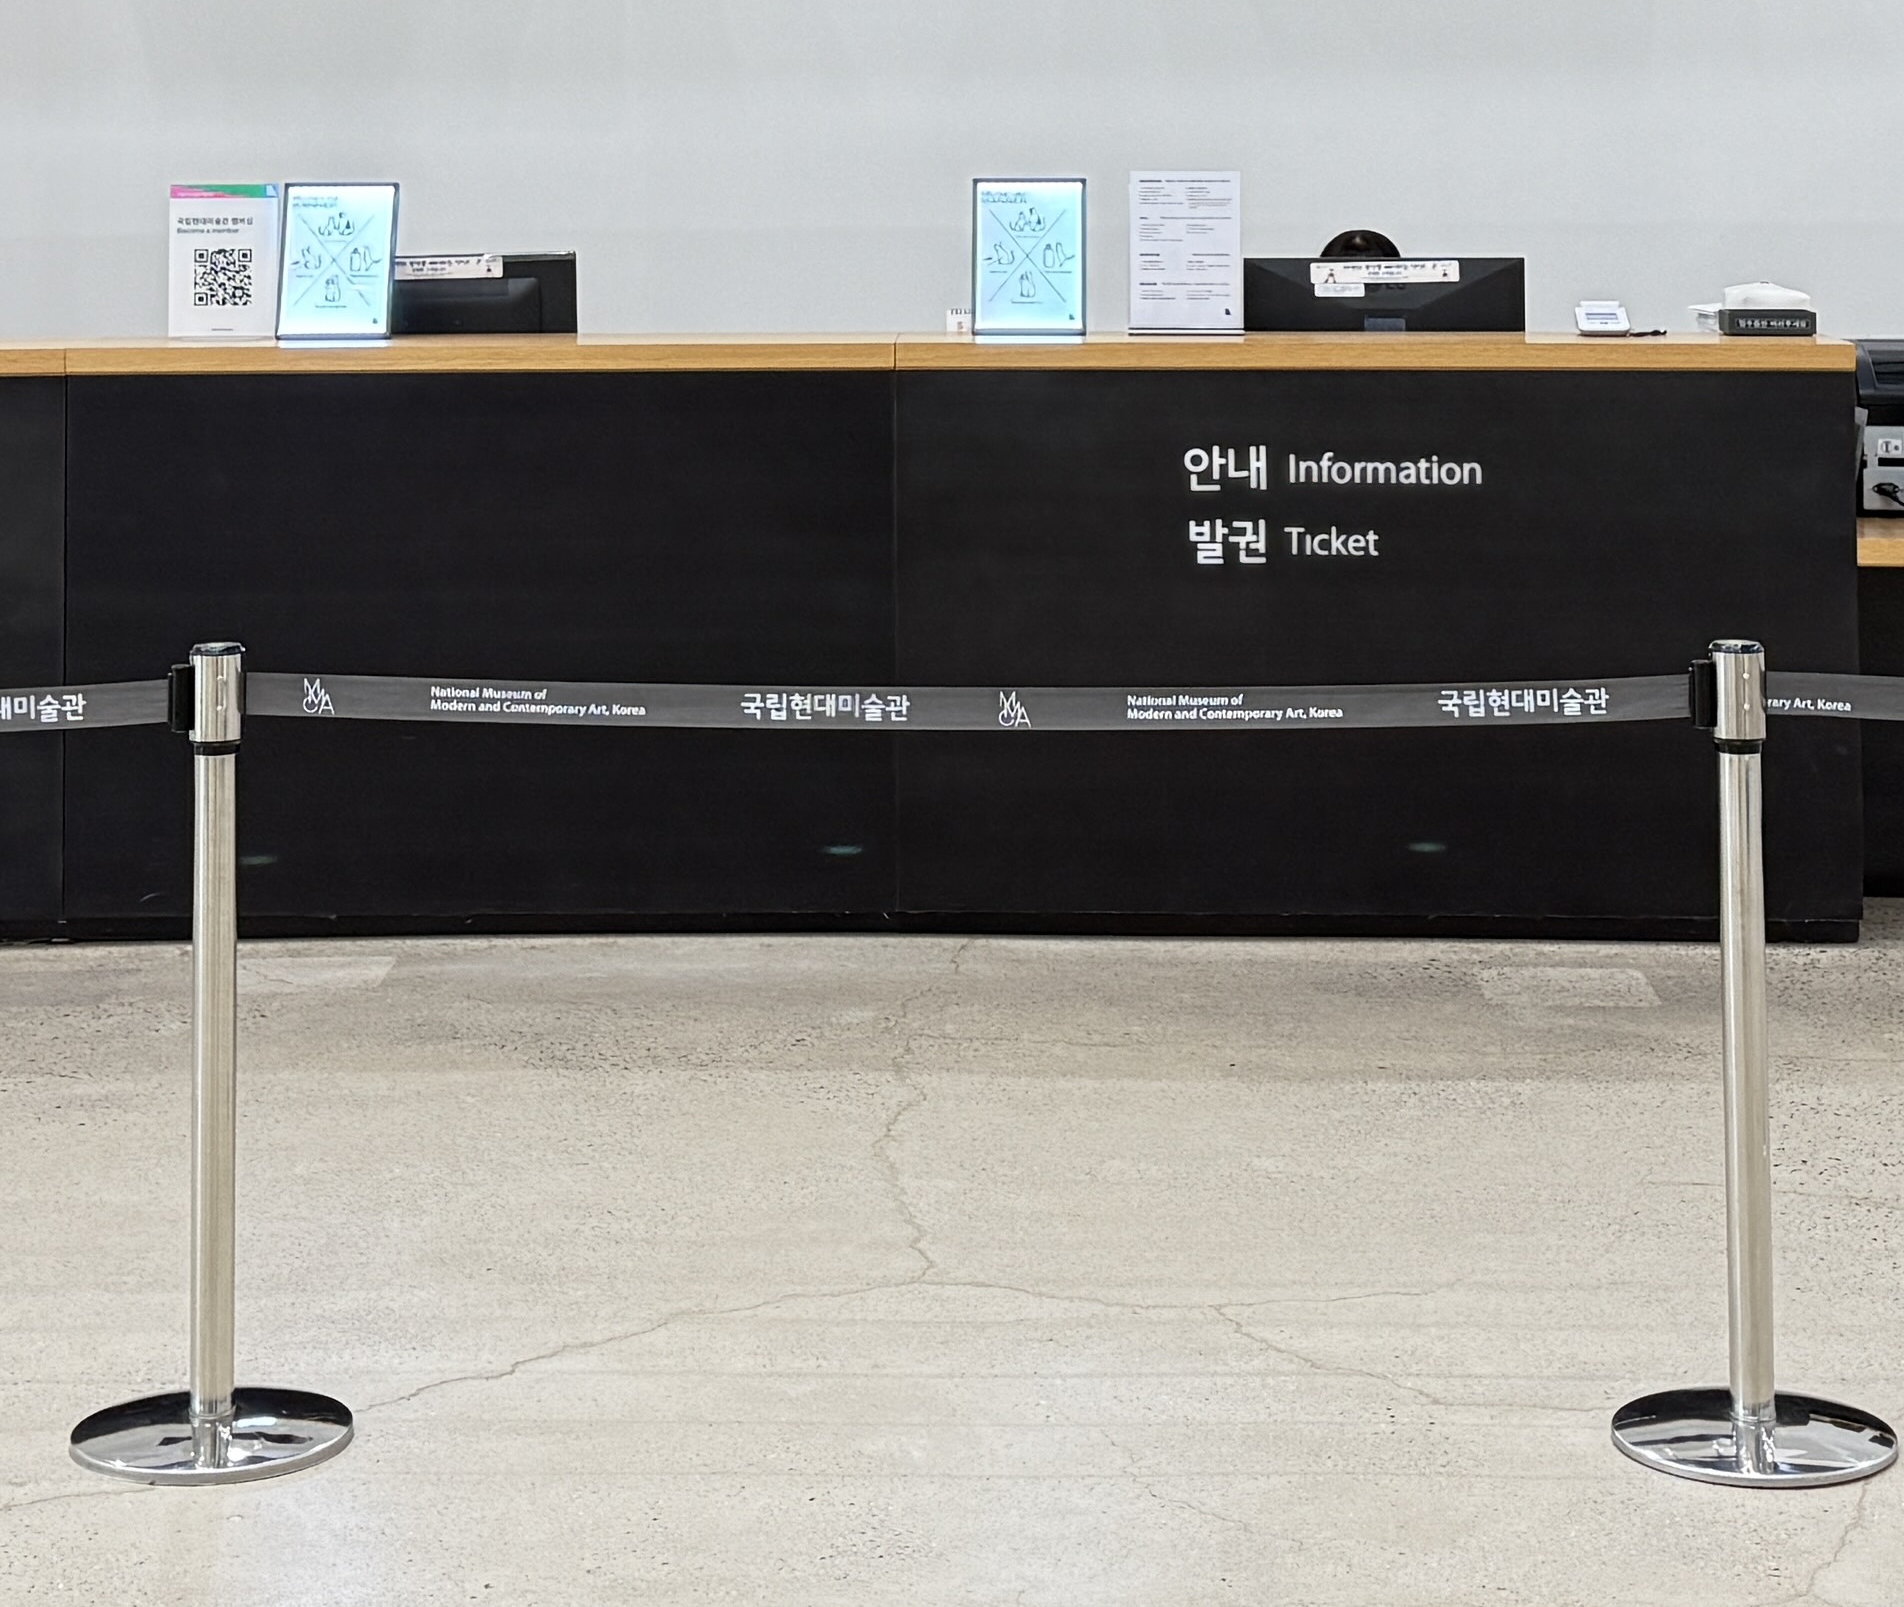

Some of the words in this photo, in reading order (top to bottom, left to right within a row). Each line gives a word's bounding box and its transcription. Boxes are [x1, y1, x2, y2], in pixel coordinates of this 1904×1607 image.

[1184, 446, 1266, 491] 안내
[1290, 452, 1481, 484] Information
[1189, 519, 1266, 564] 발권
[1284, 526, 1378, 556] Ticket
[430, 687, 479, 698] National
[482, 688, 532, 700] Museum
[534, 689, 547, 700] of
[1127, 695, 1176, 706] National
[1178, 695, 1228, 706] Museum
[1231, 694, 1243, 706] of
[430, 700, 476, 711] Modern
[478, 701, 501, 712] and
[503, 701, 586, 717] Contemporary
[612, 704, 646, 716] Korea
[741, 693, 910, 721] 국립현대미술관
[1438, 688, 1609, 717] 국립현대미술관
[1817, 699, 1851, 711] Korea
[1127, 708, 1172, 719] Modern
[1174, 708, 1197, 719] and
[1201, 708, 1283, 721] Contemporary
[1309, 707, 1343, 718] Korea
